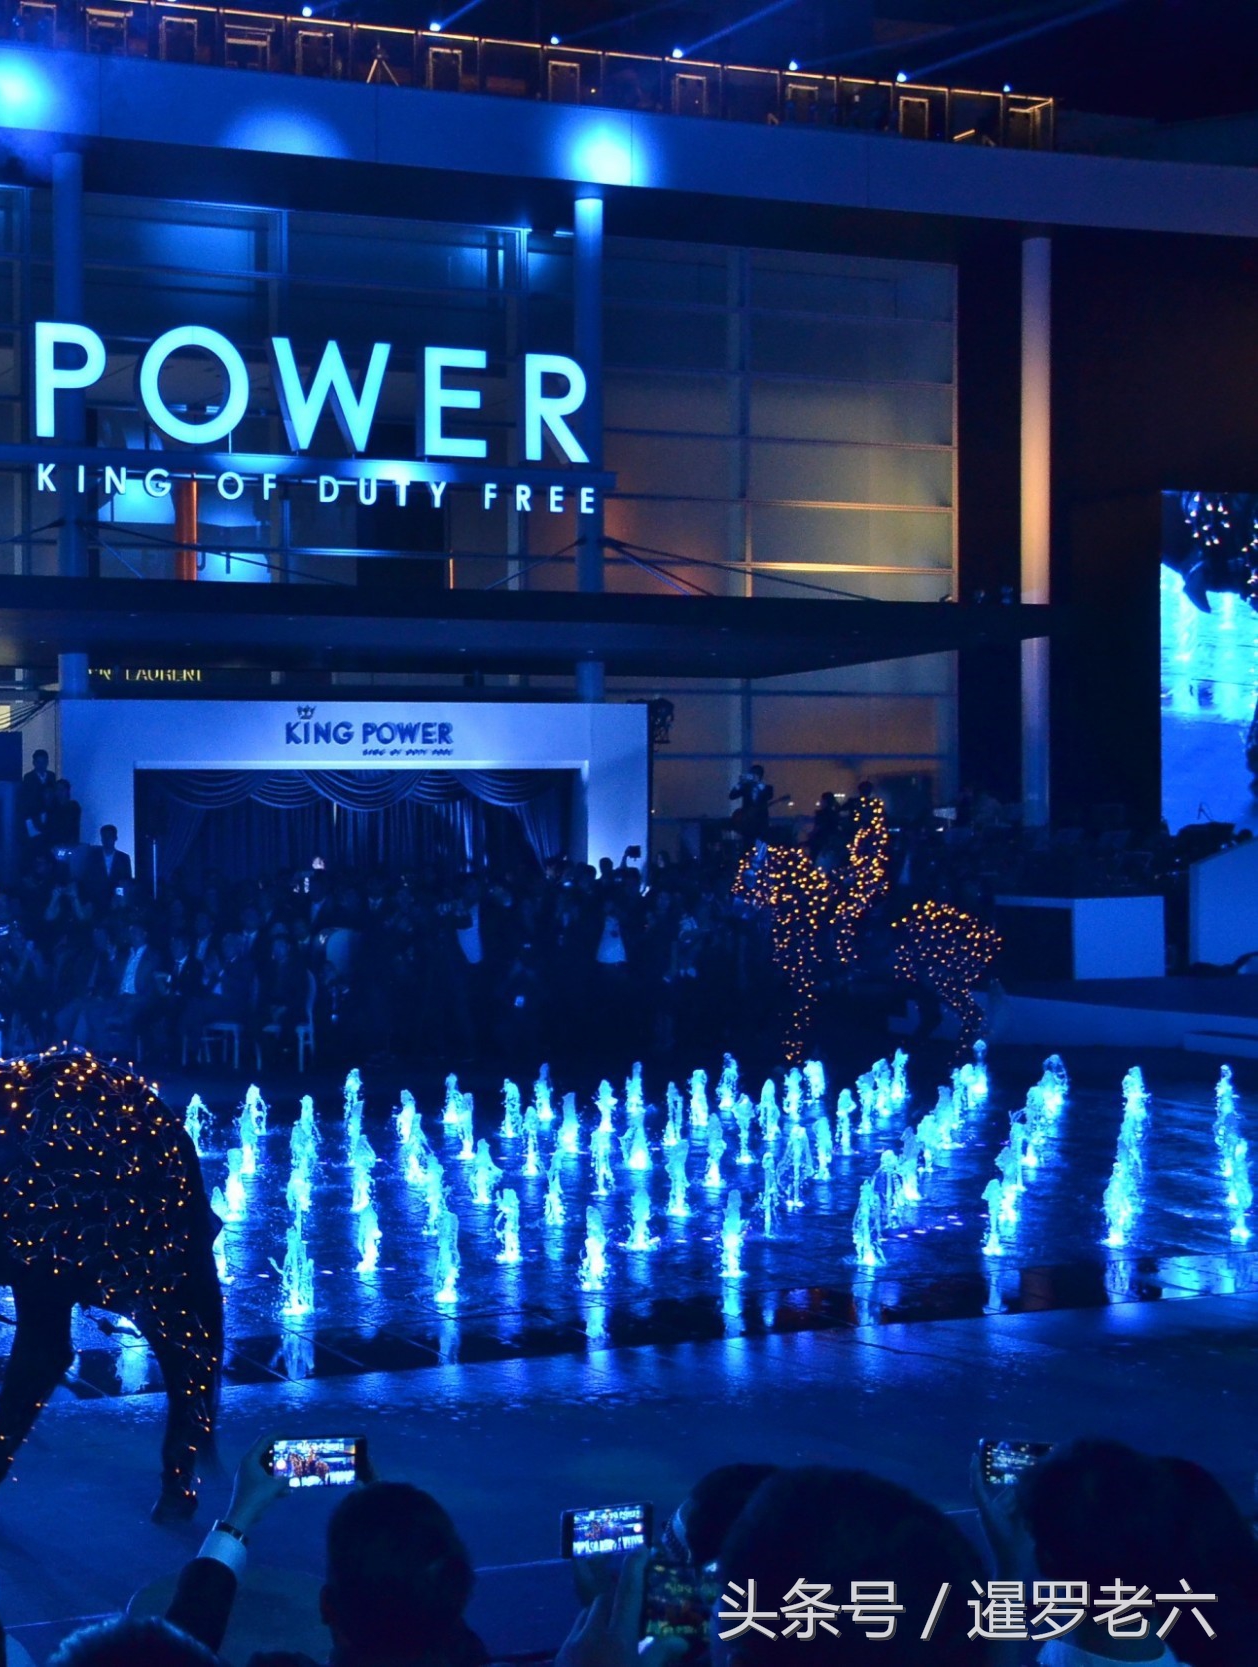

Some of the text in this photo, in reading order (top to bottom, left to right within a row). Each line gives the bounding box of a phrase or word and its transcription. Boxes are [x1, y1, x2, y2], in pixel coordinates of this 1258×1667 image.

[35, 321, 590, 464] POWER
[37, 463, 596, 515] KING OF DUTY FREE
[285, 720, 454, 745] KING POWER
